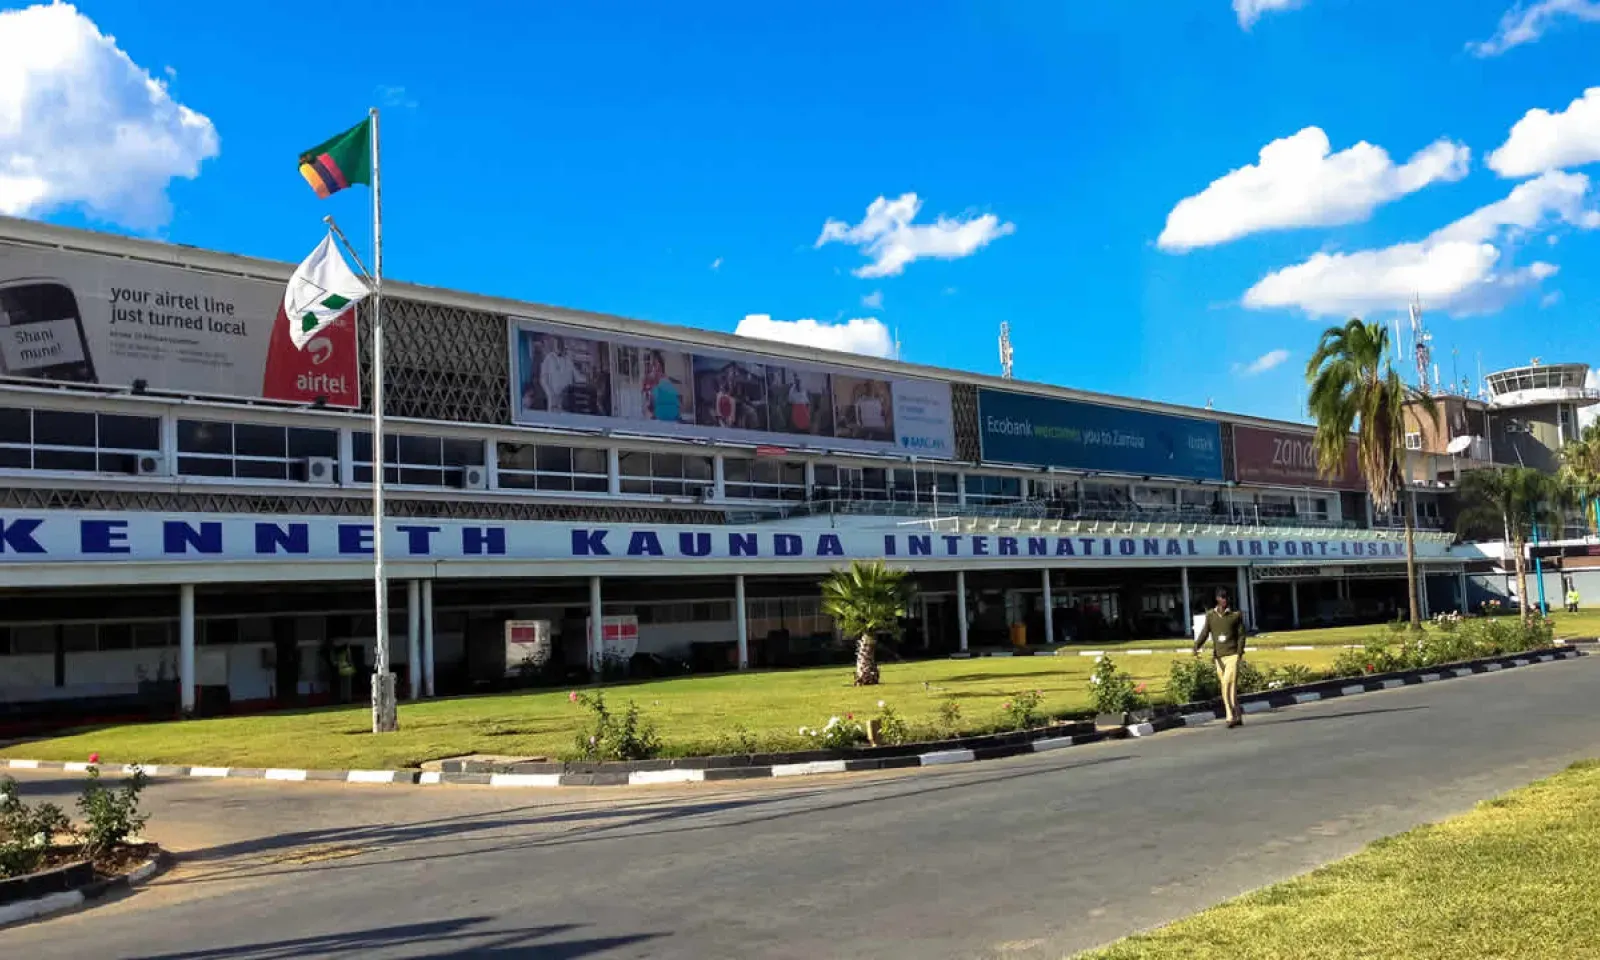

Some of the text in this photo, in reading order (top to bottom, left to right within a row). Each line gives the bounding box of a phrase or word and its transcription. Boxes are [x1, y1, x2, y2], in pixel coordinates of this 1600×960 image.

[109, 287, 235, 316] your airtel line
[109, 303, 248, 337] just turned local
[15, 328, 54, 344] Shani
[296, 370, 348, 394] airtel
[986, 415, 1032, 437] Ecobank
[0, 518, 507, 555] KENNETH
[571, 529, 845, 557] KAUNDA
[883, 534, 1199, 556] INTERNATIONAL
